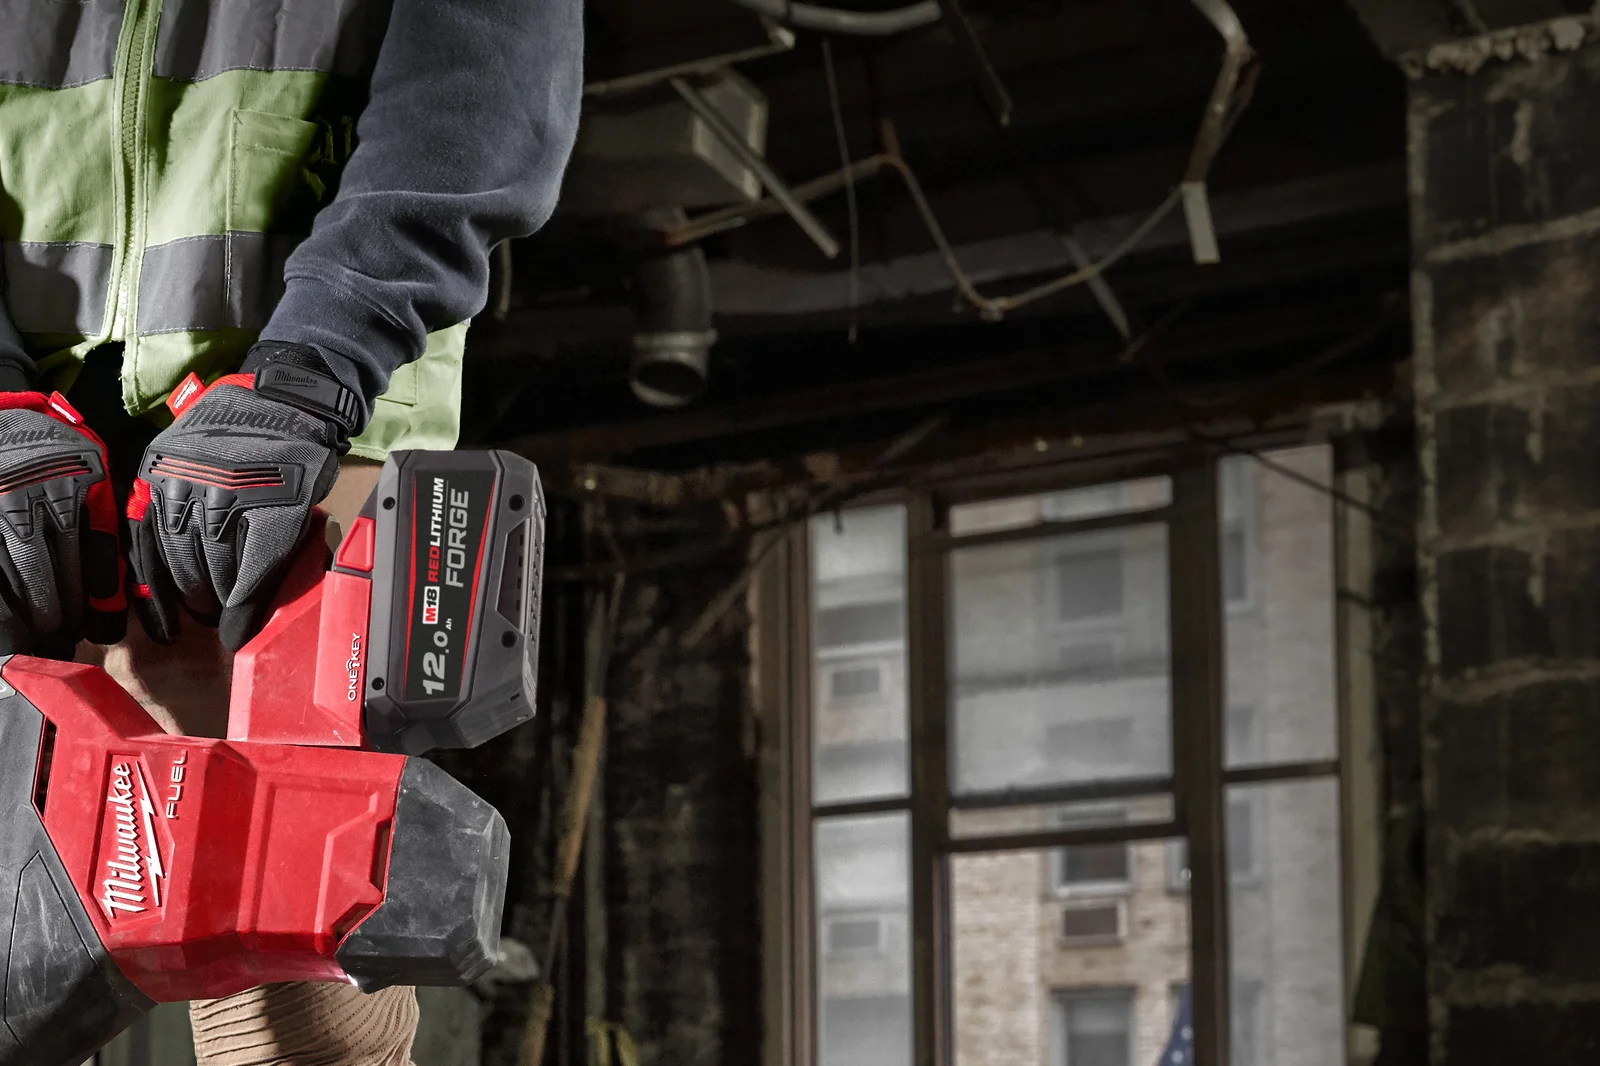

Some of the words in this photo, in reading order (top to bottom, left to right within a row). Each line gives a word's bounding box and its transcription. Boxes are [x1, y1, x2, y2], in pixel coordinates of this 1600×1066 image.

[427, 477, 445, 583] REDLITHIUM
[445, 488, 470, 588] FORGE
[425, 587, 439, 622] M18
[421, 631, 450, 697] 12.0
[445, 618, 453, 631] Ah
[166, 750, 188, 819] FUEL
[102, 761, 148, 918] Milwaukee
